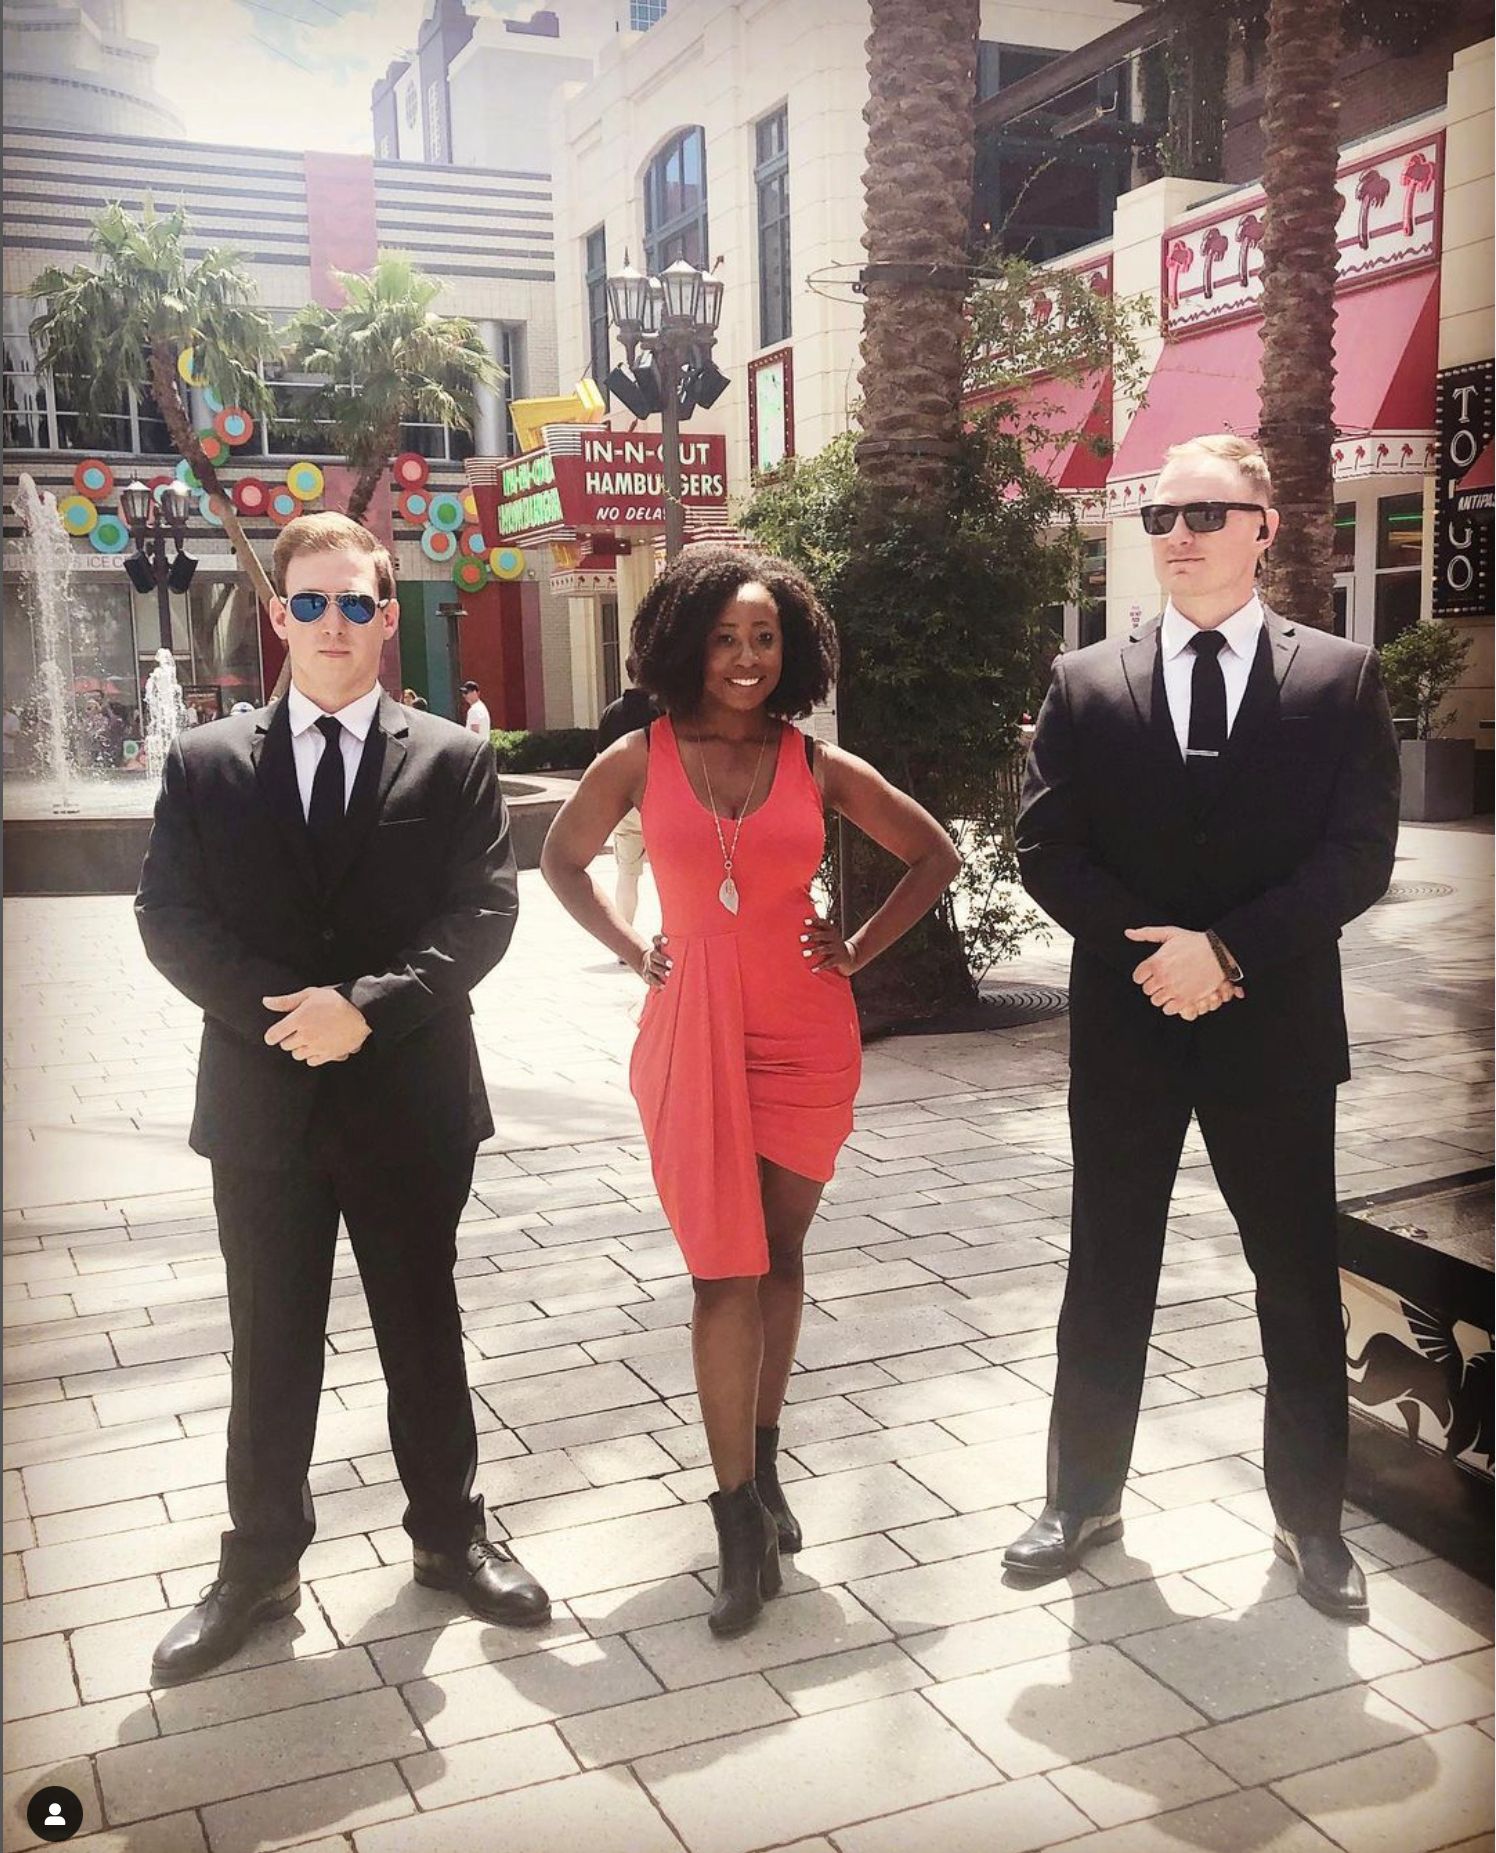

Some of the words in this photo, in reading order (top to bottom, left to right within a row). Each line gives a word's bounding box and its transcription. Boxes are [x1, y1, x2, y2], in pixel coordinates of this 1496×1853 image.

[585, 472, 724, 497] HAMBUGERS
[596, 507, 620, 521] NO
[87, 555, 110, 569] ICE
